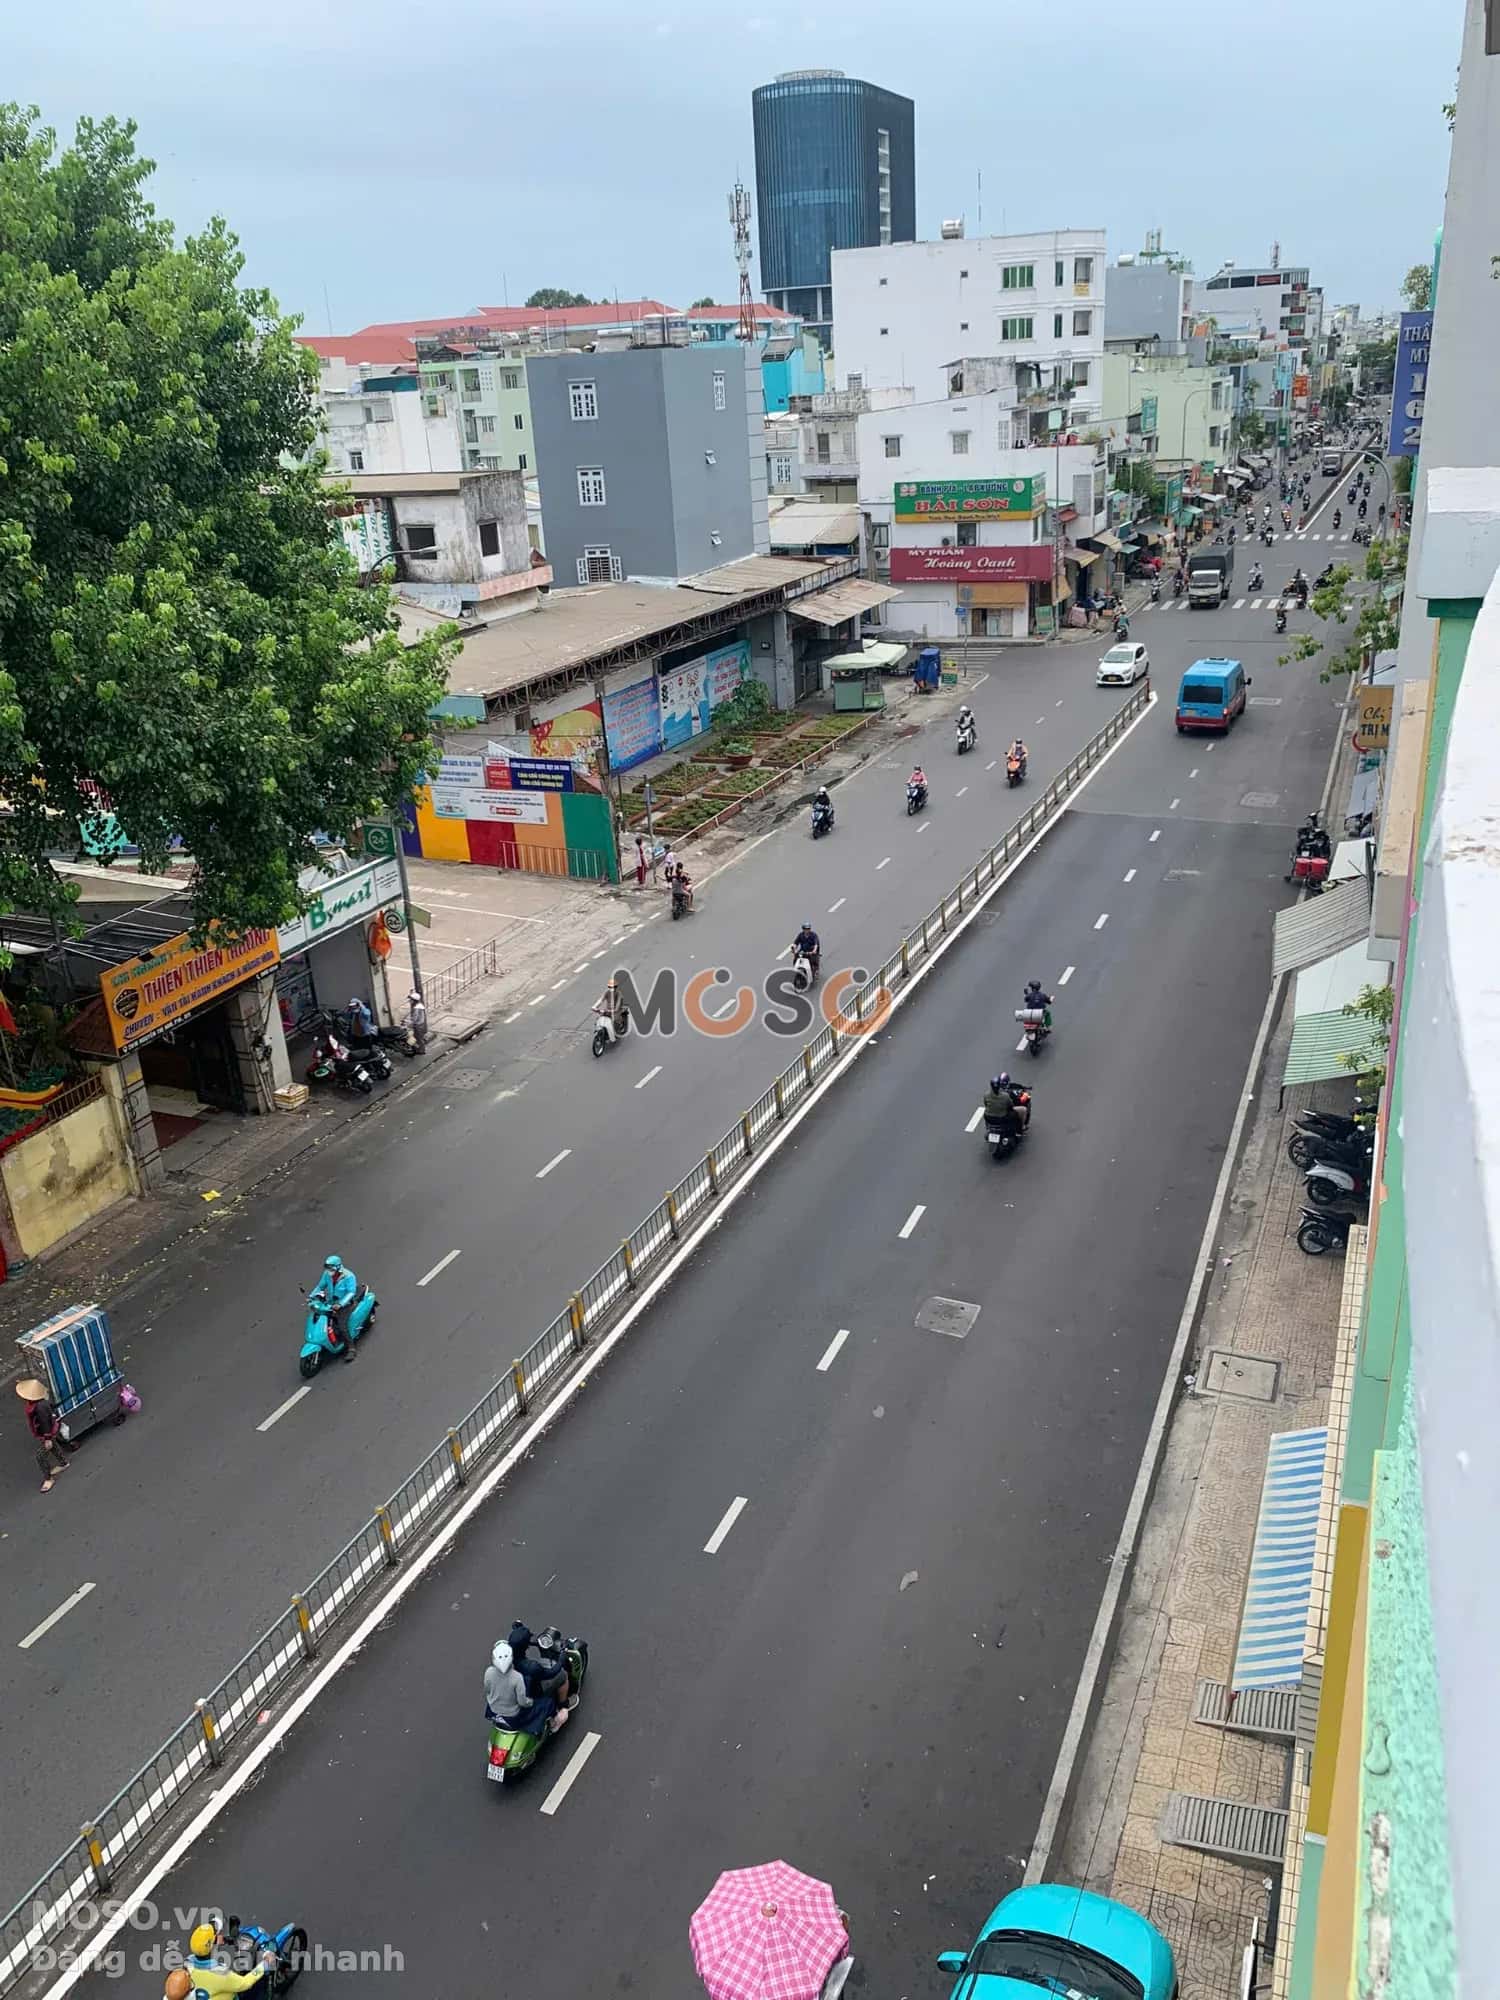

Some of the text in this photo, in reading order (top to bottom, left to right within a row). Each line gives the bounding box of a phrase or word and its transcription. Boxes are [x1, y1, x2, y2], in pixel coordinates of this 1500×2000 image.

[915, 495, 1010, 512] HẢI SƠN
[977, 557, 1016, 568] Oanh
